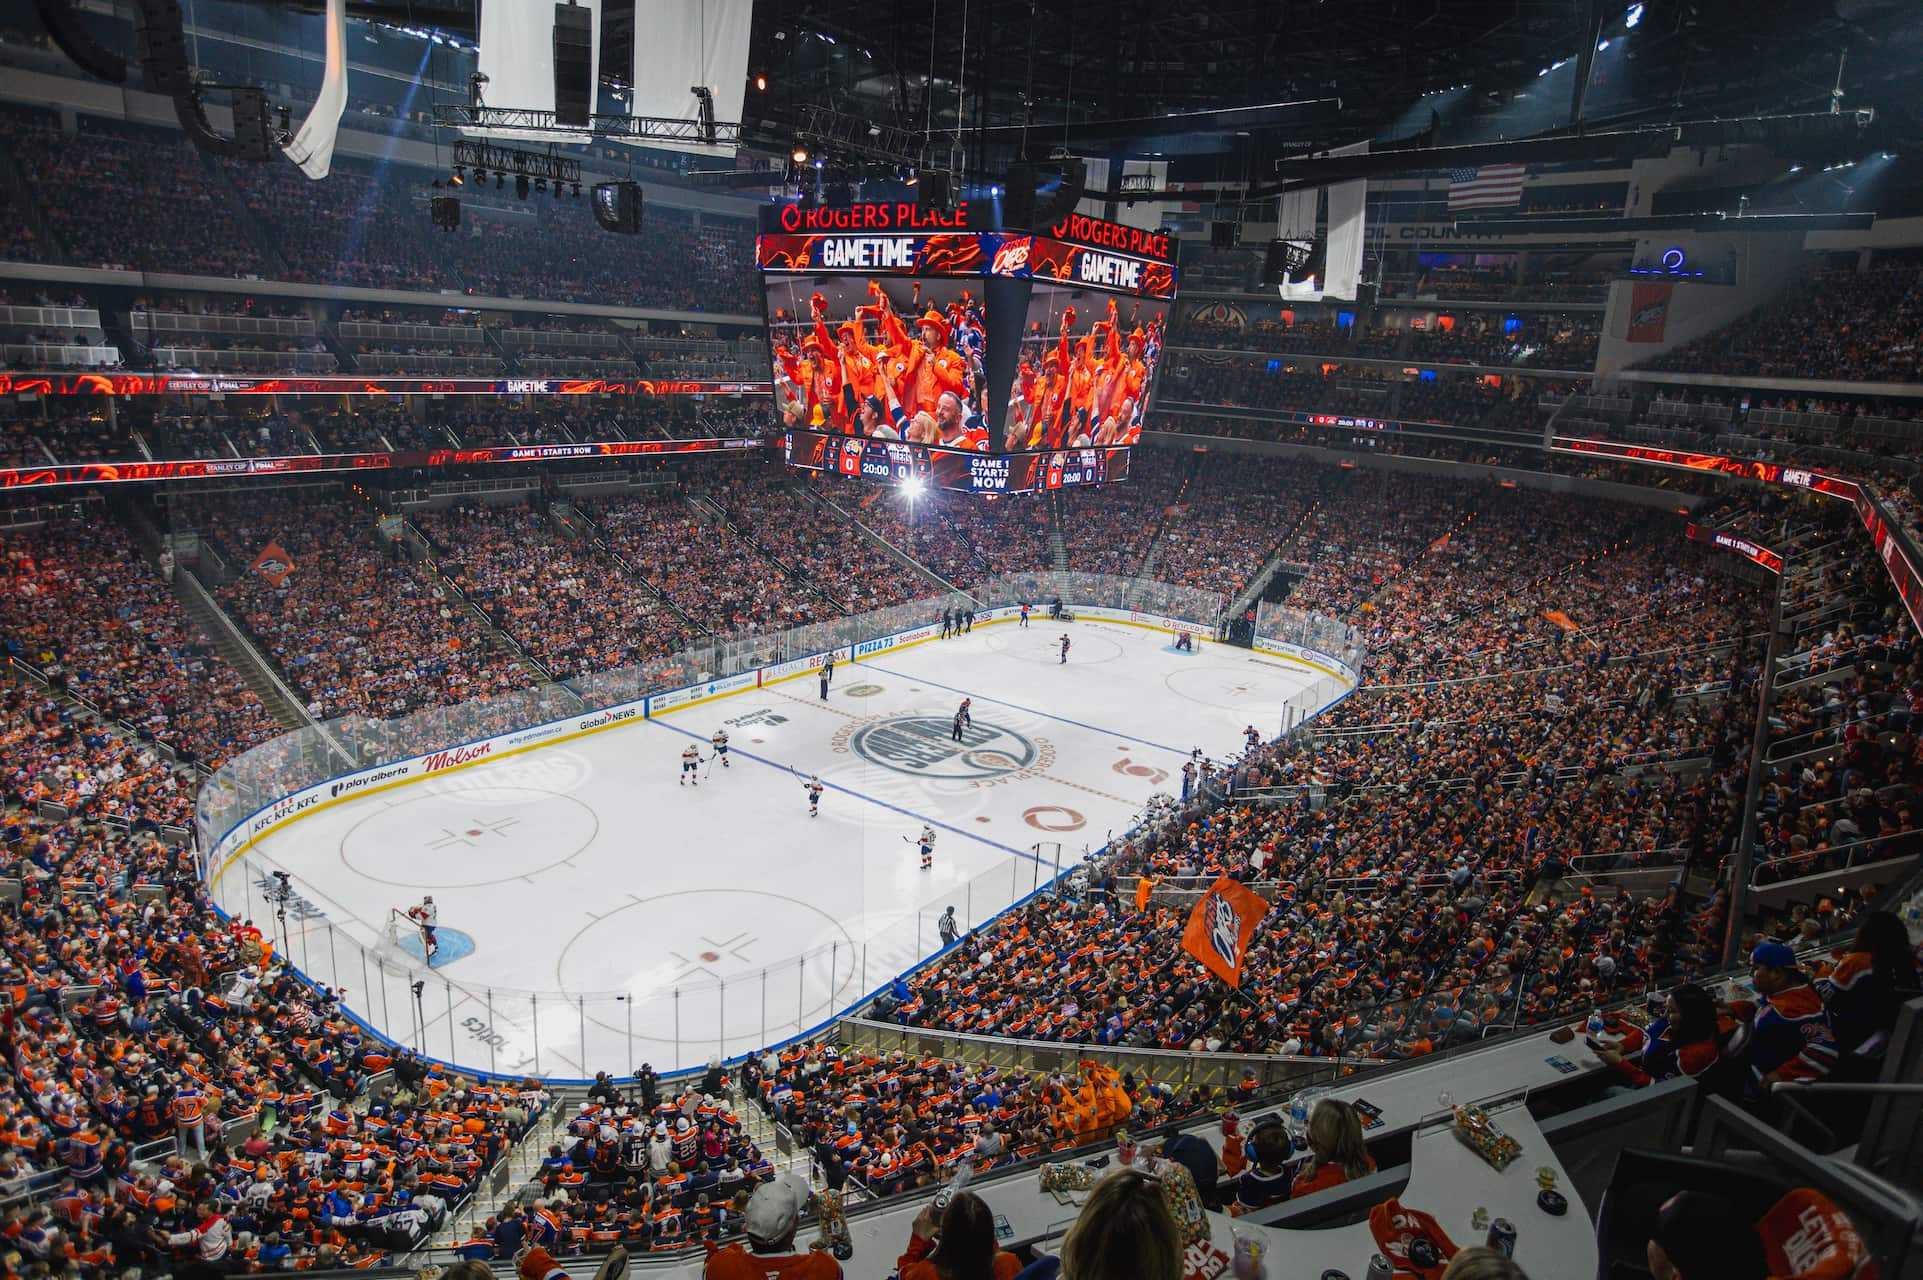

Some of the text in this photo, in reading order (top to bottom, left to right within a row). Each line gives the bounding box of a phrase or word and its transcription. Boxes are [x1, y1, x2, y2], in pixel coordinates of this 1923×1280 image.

[806, 202, 968, 228] ROGERS PLACE
[1070, 213, 1168, 258] ROGERS PLACE
[823, 239, 914, 267] GAMETIME
[1081, 253, 1140, 288] GAMETIME
[507, 380, 548, 393] GAMETIME
[513, 449, 535, 458] GAME
[544, 448, 572, 456] STARTS
[574, 446, 591, 455] NOW
[846, 458, 906, 478] 0 20:00 0
[971, 467, 1009, 477] STARTS
[972, 459, 1009, 468] GAME 1
[973, 477, 1007, 489] NOW
[1051, 470, 1092, 485] 0 20:00 0
[899, 629, 931, 644] Scotiabank
[859, 637, 894, 654] PIZZA 73
[580, 708, 635, 730] Global NEWS
[422, 742, 491, 772] Molson
[345, 767, 408, 791] play alberta
[254, 794, 319, 832] KFC KFC KFC
[631, 1148, 646, 1164] 16
[680, 1141, 697, 1158] 28
